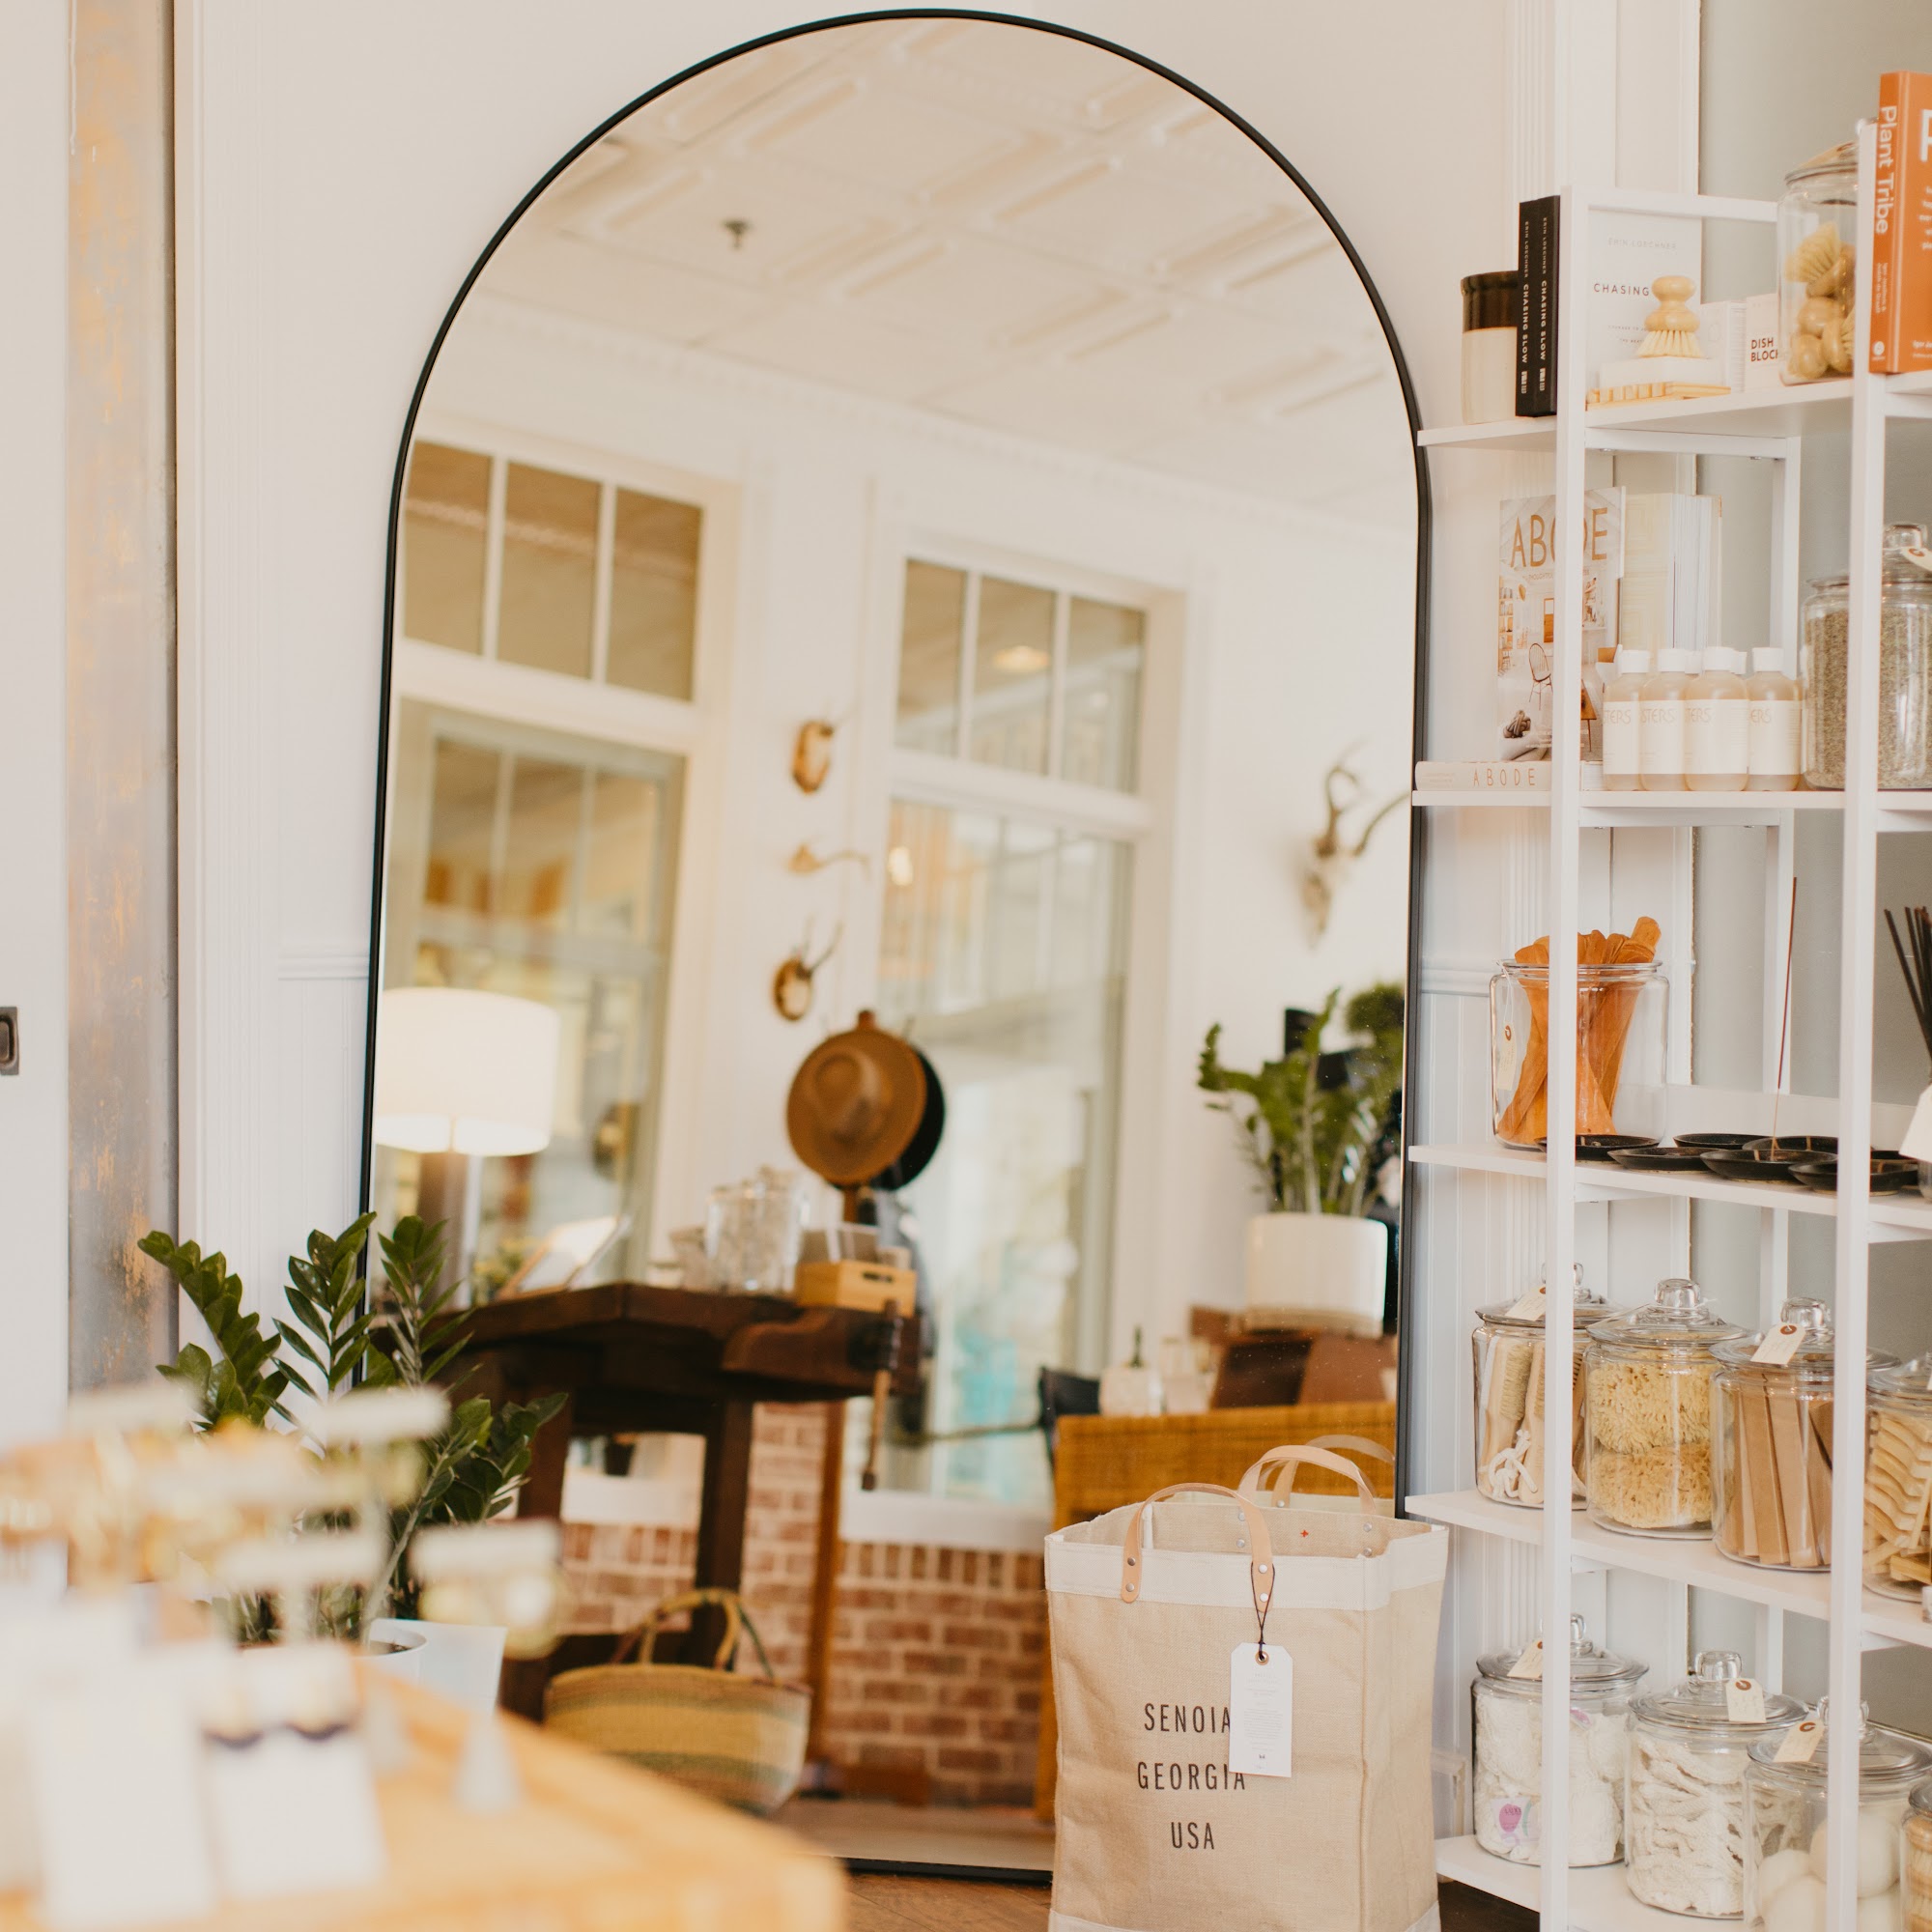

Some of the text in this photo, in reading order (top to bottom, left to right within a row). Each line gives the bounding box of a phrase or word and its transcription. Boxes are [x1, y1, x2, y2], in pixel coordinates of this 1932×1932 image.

[1876, 105, 1897, 234] Plant Tribe
[1593, 282, 1650, 297] CHASING
[1750, 337, 1774, 349] DISH
[1510, 507, 1607, 568] ABE
[1473, 768, 1536, 786] ABODE
[1144, 1702, 1231, 1733] SENOIA
[1137, 1761, 1245, 1790] GEORGIA
[1171, 1822, 1214, 1850] USA
